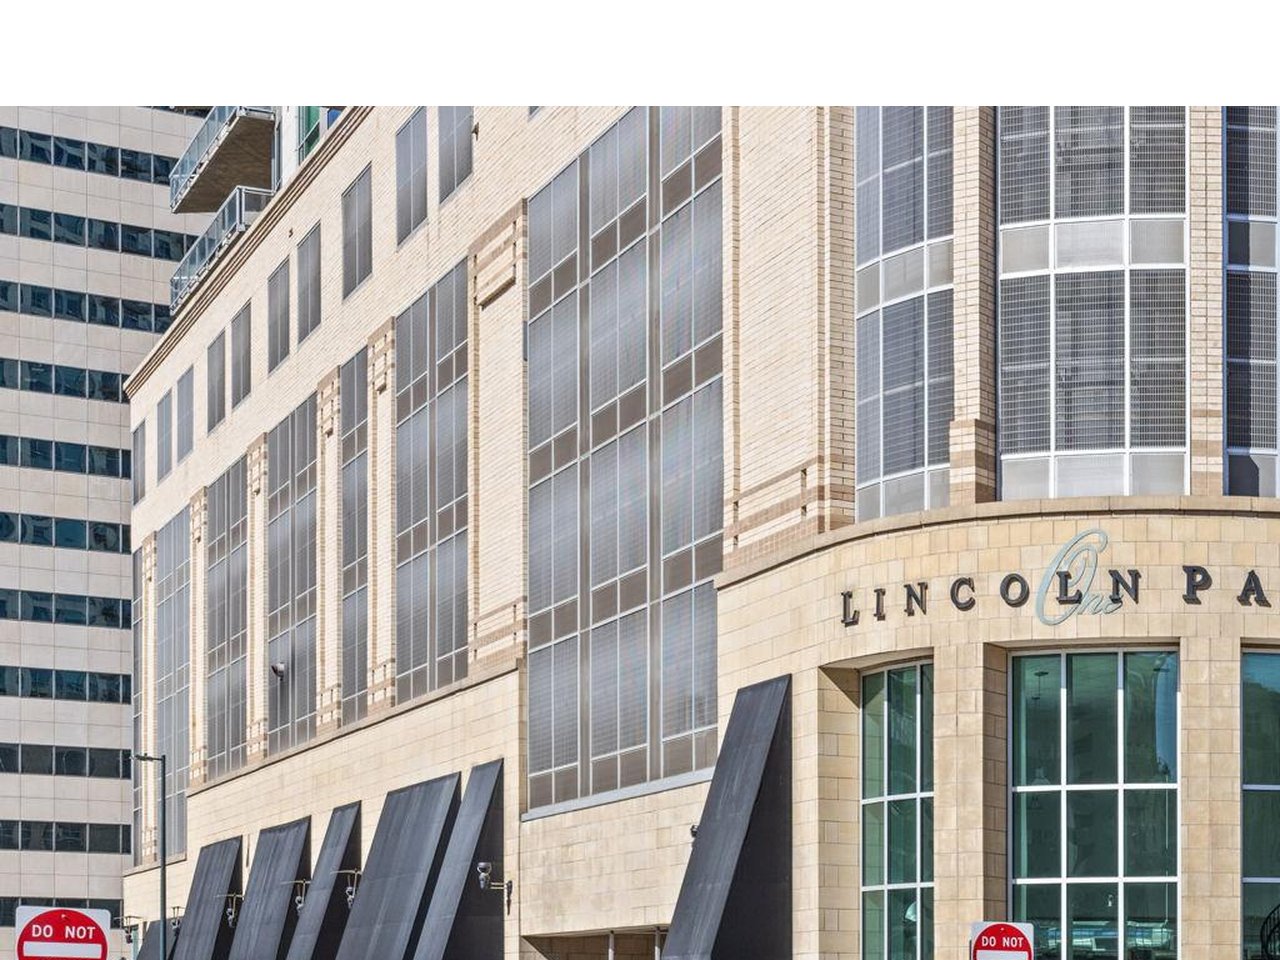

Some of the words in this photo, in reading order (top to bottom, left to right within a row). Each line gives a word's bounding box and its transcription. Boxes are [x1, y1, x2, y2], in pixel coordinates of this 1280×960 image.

[840, 568, 1141, 627] LINCOLN
[32, 924, 53, 938] DO
[65, 926, 96, 939] NOT
[981, 936, 996, 947] DO
[1002, 937, 1024, 948] NOT
